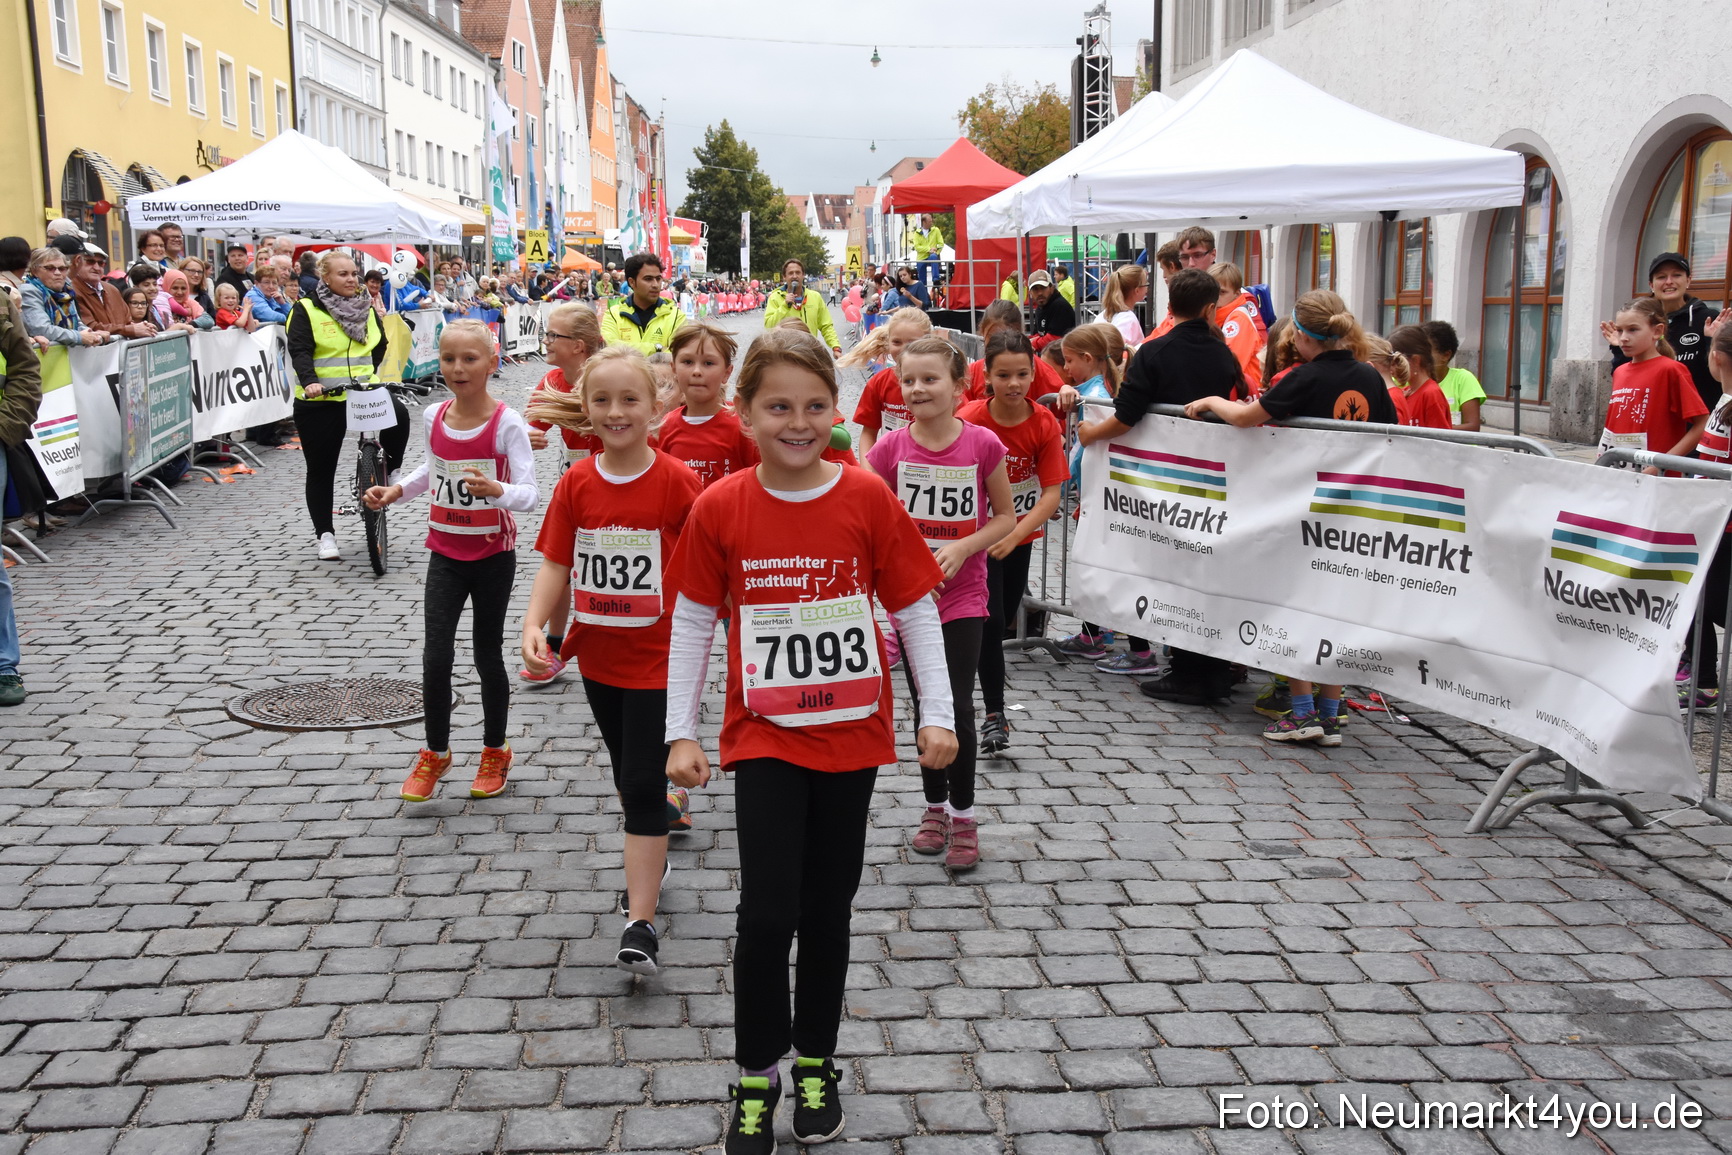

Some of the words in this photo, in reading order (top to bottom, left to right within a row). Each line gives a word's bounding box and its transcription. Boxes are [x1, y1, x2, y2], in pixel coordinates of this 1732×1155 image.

[142, 202, 176, 212] BMW
[181, 200, 281, 212] ConnectedDrive
[143, 214, 183, 222] Vernetzt,
[530, 240, 544, 256] A
[850, 254, 859, 265] A
[369, 400, 387, 408] Mann
[1639, 388, 1650, 424] BAMBINI
[353, 410, 387, 420] Jugendlauf
[936, 468, 975, 479] BOCK
[906, 483, 974, 517] 7158
[1014, 490, 1037, 514] 26
[446, 512, 471, 524] Alina
[1104, 487, 1228, 534] NeuerMarkt
[919, 523, 958, 538] Sophia
[602, 534, 651, 546] BOCK
[1301, 520, 1472, 574] NeuerMarkt
[578, 552, 652, 590] 7032
[742, 556, 827, 572] Neumarkter
[745, 574, 809, 590] Stadtlauf
[589, 597, 631, 614] Sophie
[1544, 566, 1679, 630] NeuerMarkt
[800, 600, 864, 621] BOCK
[752, 618, 793, 626] NeuerMarkt
[1150, 614, 1190, 633] Neumarkt
[756, 627, 868, 680] 7093
[1282, 645, 1298, 659] Uhr
[1316, 639, 1332, 665] P
[1336, 643, 1358, 658] über
[1360, 648, 1382, 661] 500
[1336, 659, 1394, 676] Parkplätze
[749, 679, 755, 687] 5
[797, 690, 834, 708] Jule
[1436, 678, 1511, 710] NM-Neumarkt
